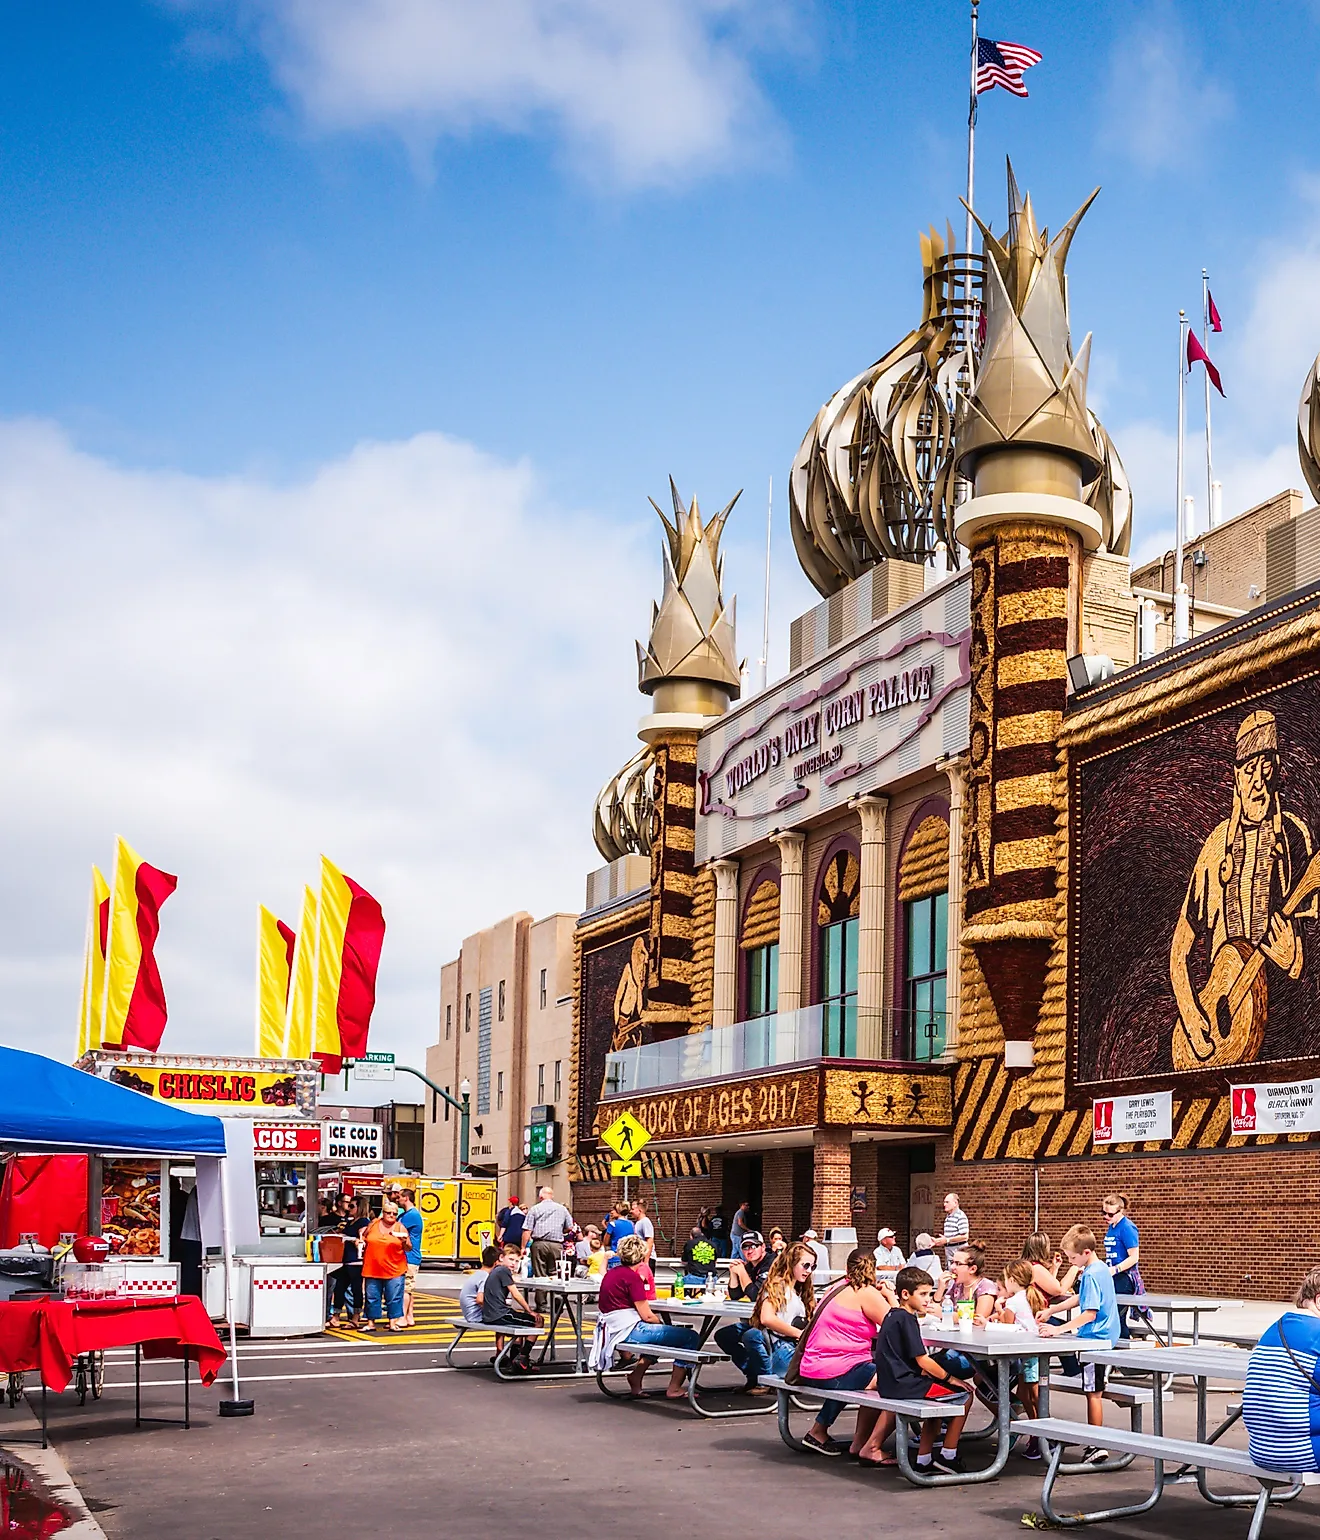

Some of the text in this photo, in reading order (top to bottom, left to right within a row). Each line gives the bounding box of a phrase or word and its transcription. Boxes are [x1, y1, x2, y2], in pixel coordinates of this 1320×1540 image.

[725, 664, 933, 799] WORLD'S ONLY CORN PALACE
[358, 1053, 393, 1062] ARKING
[158, 1073, 256, 1101] CHISLIC
[1267, 1084, 1314, 1097] DIAMOND RIO
[638, 1099, 678, 1134] ROCK
[683, 1096, 702, 1131] OF
[708, 1087, 752, 1128] AGES
[759, 1081, 800, 1121] 2017
[1128, 1098, 1155, 1109] GARY LEWIS
[1267, 1098, 1314, 1109] BLACK HAWK
[1233, 1115, 1256, 1128] Coca-Cola
[254, 1130, 298, 1149] COS
[329, 1126, 378, 1141] ICE COLD
[329, 1144, 378, 1159] DRINKS
[471, 1146, 480, 1156] CITY
